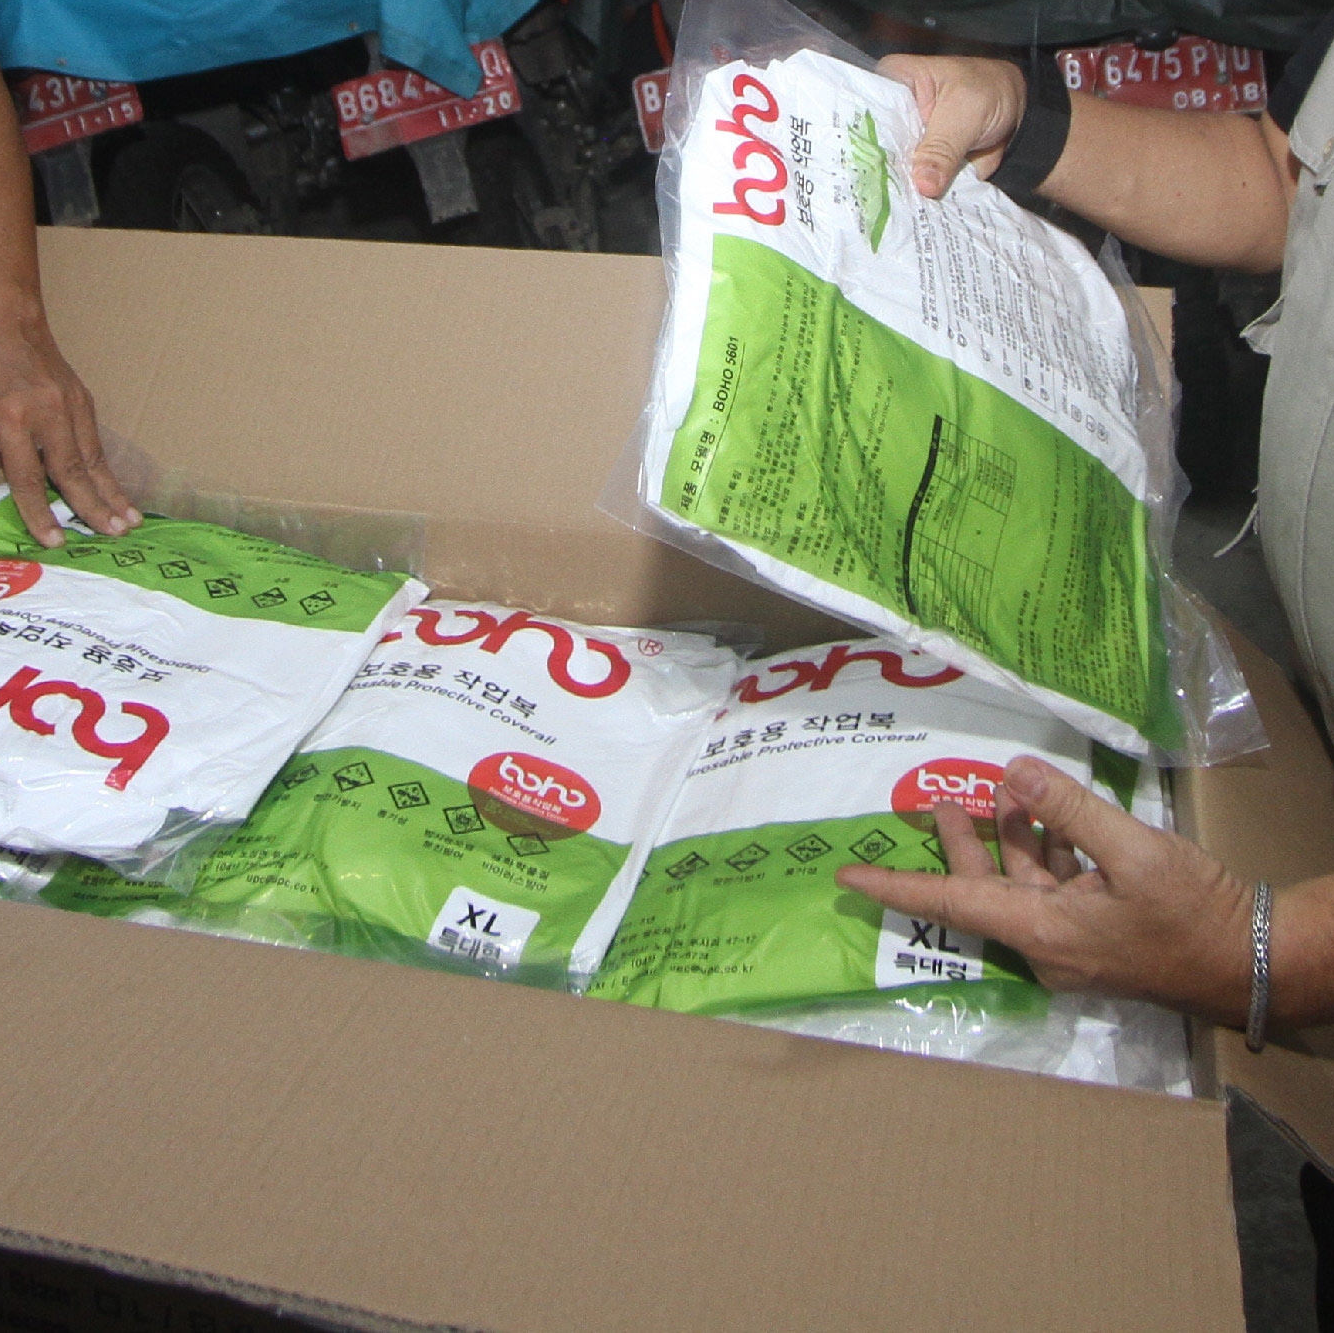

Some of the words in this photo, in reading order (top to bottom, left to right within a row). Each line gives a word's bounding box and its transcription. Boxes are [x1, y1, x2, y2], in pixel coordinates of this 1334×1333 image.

[1066, 59, 1082, 90] B
[1104, 46, 1183, 86] 6475
[642, 80, 662, 113] B
[789, 114, 814, 168] 작업복
[794, 170, 815, 233] 보호용
[713, 368, 734, 413] BOHO
[725, 336, 740, 366] 5601
[84, 643, 172, 684] 보호용
[125, 642, 211, 674] Disposable
[404, 680, 486, 712] Protective
[489, 709, 557, 746] Coverall
[453, 668, 539, 719] 작업복
[700, 721, 788, 760] 보호용
[801, 712, 896, 732] 작업복
[757, 733, 845, 758] Protective
[851, 732, 928, 745] Coverall
[457, 902, 501, 937] XL
[908, 919, 960, 954] XL
